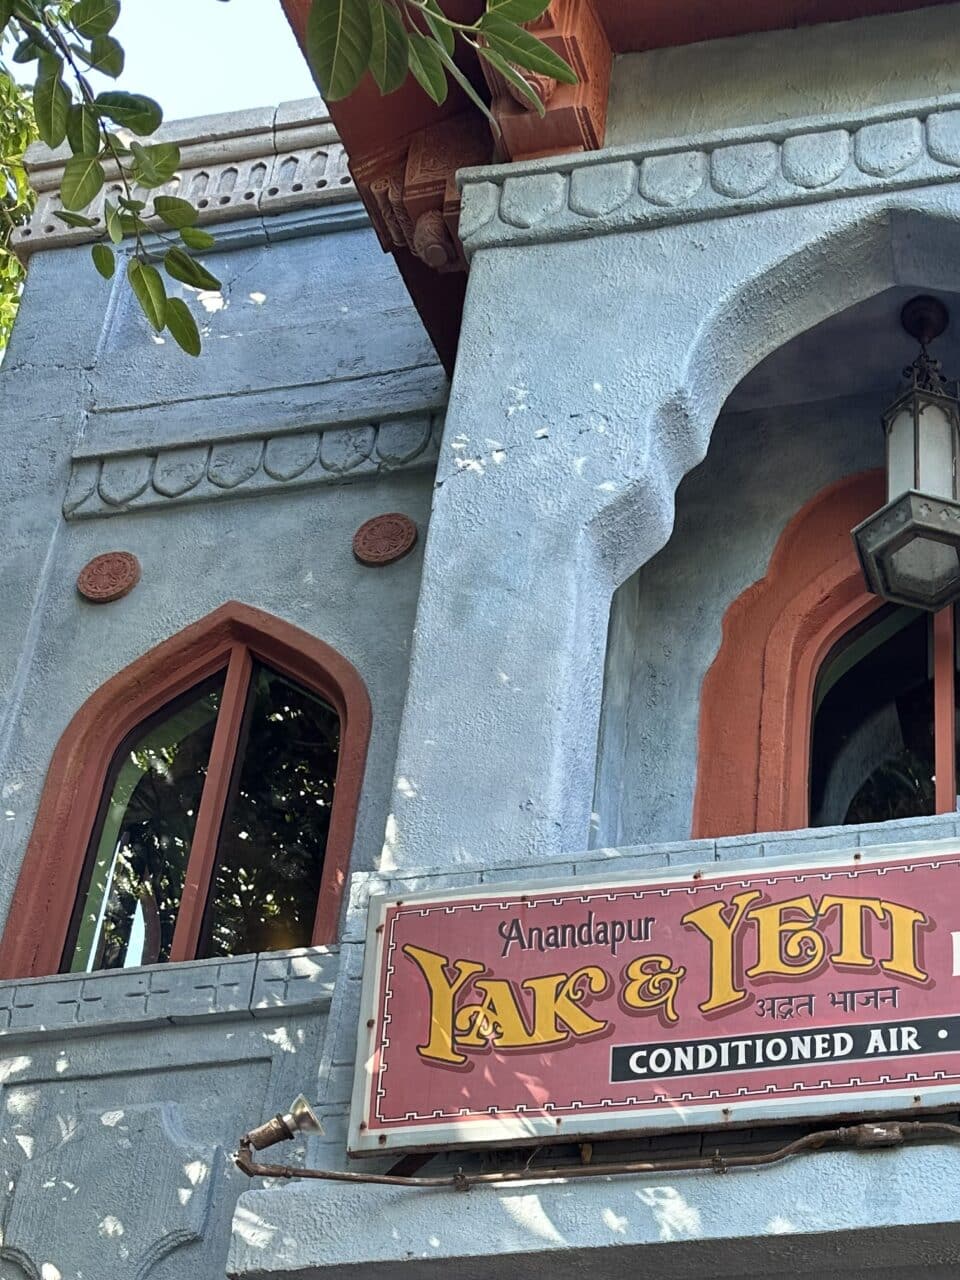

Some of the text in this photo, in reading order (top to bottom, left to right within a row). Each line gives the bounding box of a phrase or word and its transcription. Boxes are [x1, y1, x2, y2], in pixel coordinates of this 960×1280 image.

[498, 911, 655, 957] Anandapur
[403, 890, 928, 1065] YAK & YETI
[629, 1034, 854, 1075] CONDITIONED
[864, 1027, 921, 1055] AIR
